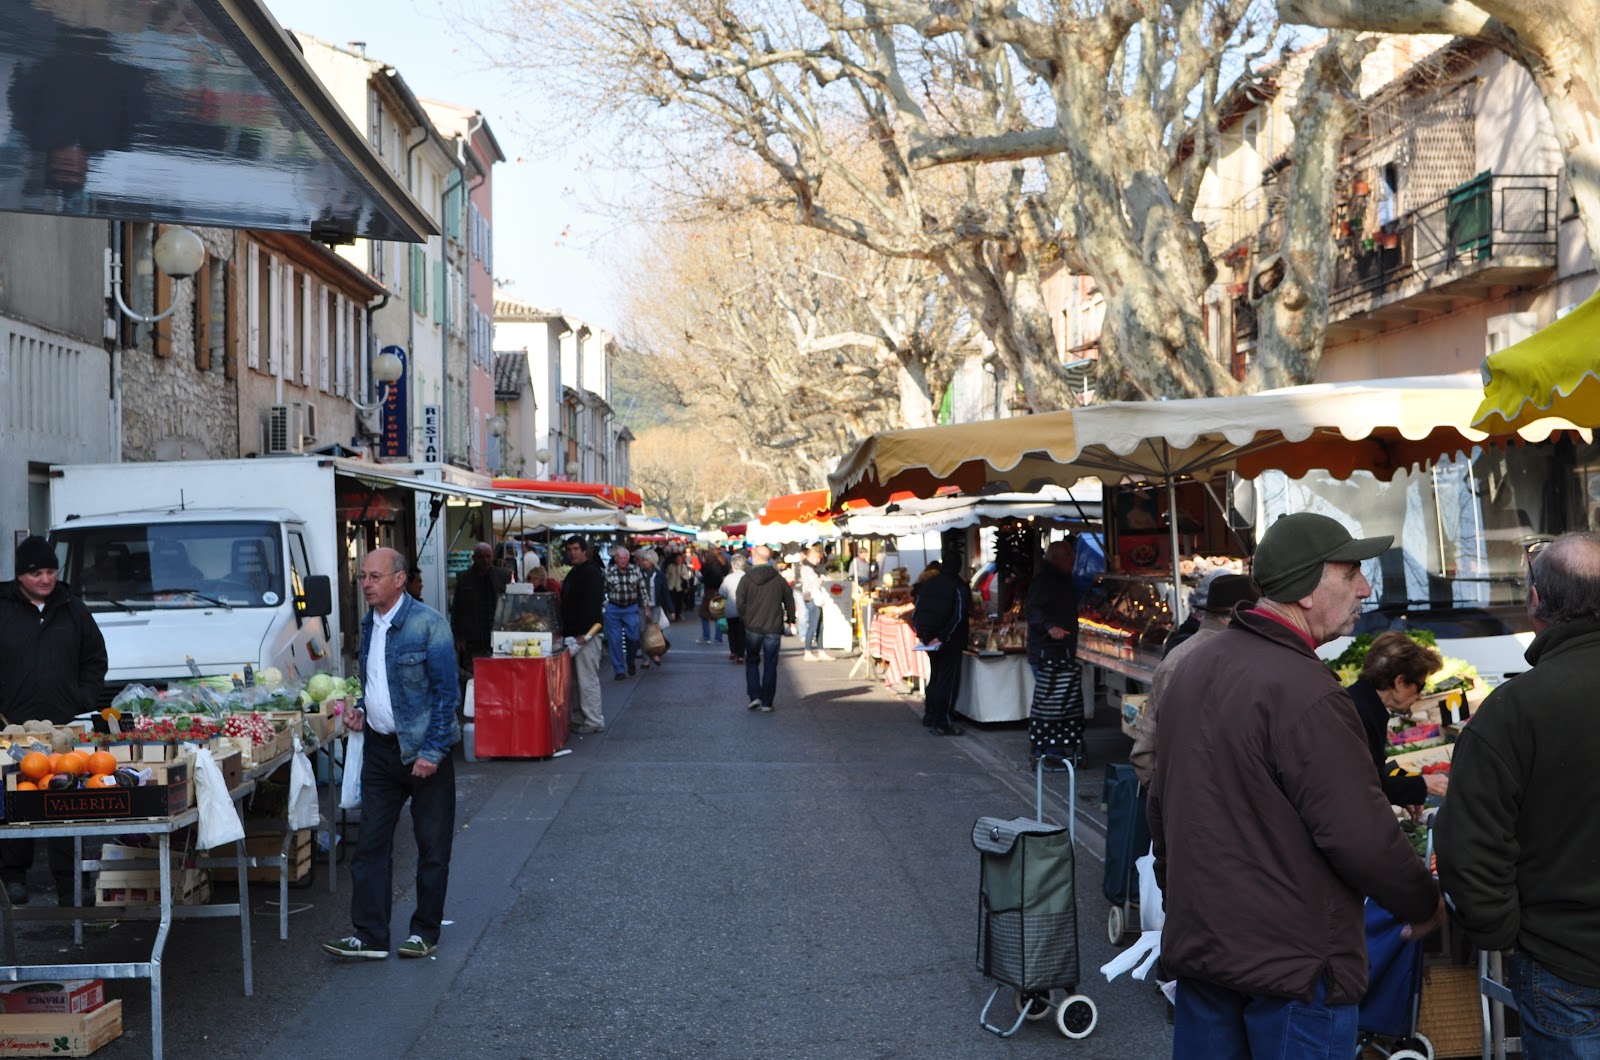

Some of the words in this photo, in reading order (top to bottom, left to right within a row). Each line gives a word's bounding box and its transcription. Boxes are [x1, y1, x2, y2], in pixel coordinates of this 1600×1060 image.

[387, 415, 399, 455] FORME
[425, 406, 437, 463] RESTAU
[50, 797, 126, 811] VALERITA
[26, 996, 65, 1004] FRANCE
